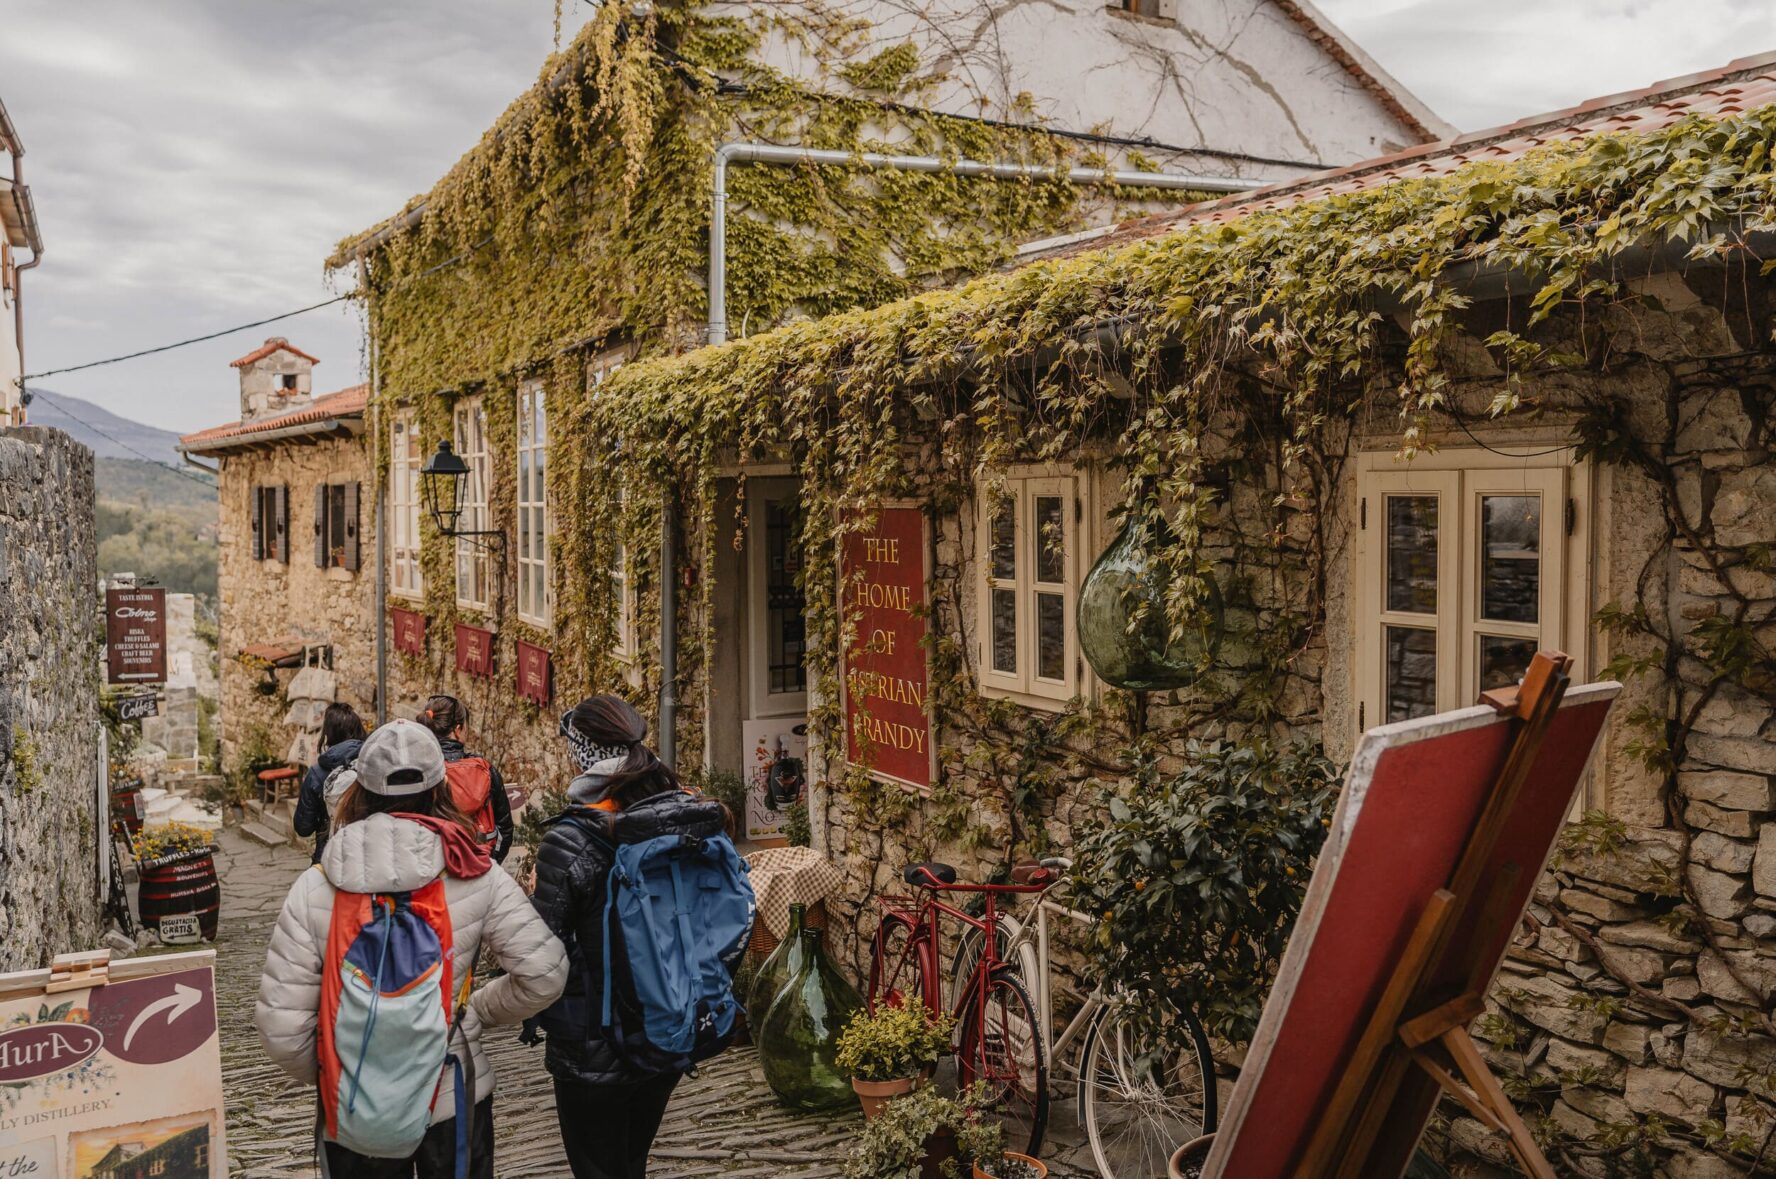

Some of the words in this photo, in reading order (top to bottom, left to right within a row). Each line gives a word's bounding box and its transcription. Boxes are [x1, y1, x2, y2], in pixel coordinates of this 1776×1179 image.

[863, 537, 899, 563] THE
[856, 583, 910, 611] HOME
[873, 629, 895, 655] OF
[152, 851, 190, 866] TRUFFLES
[162, 925, 193, 935] GRATIS
[24, 1099, 111, 1126] DISTILLERY
[9, 1155, 39, 1177] the
